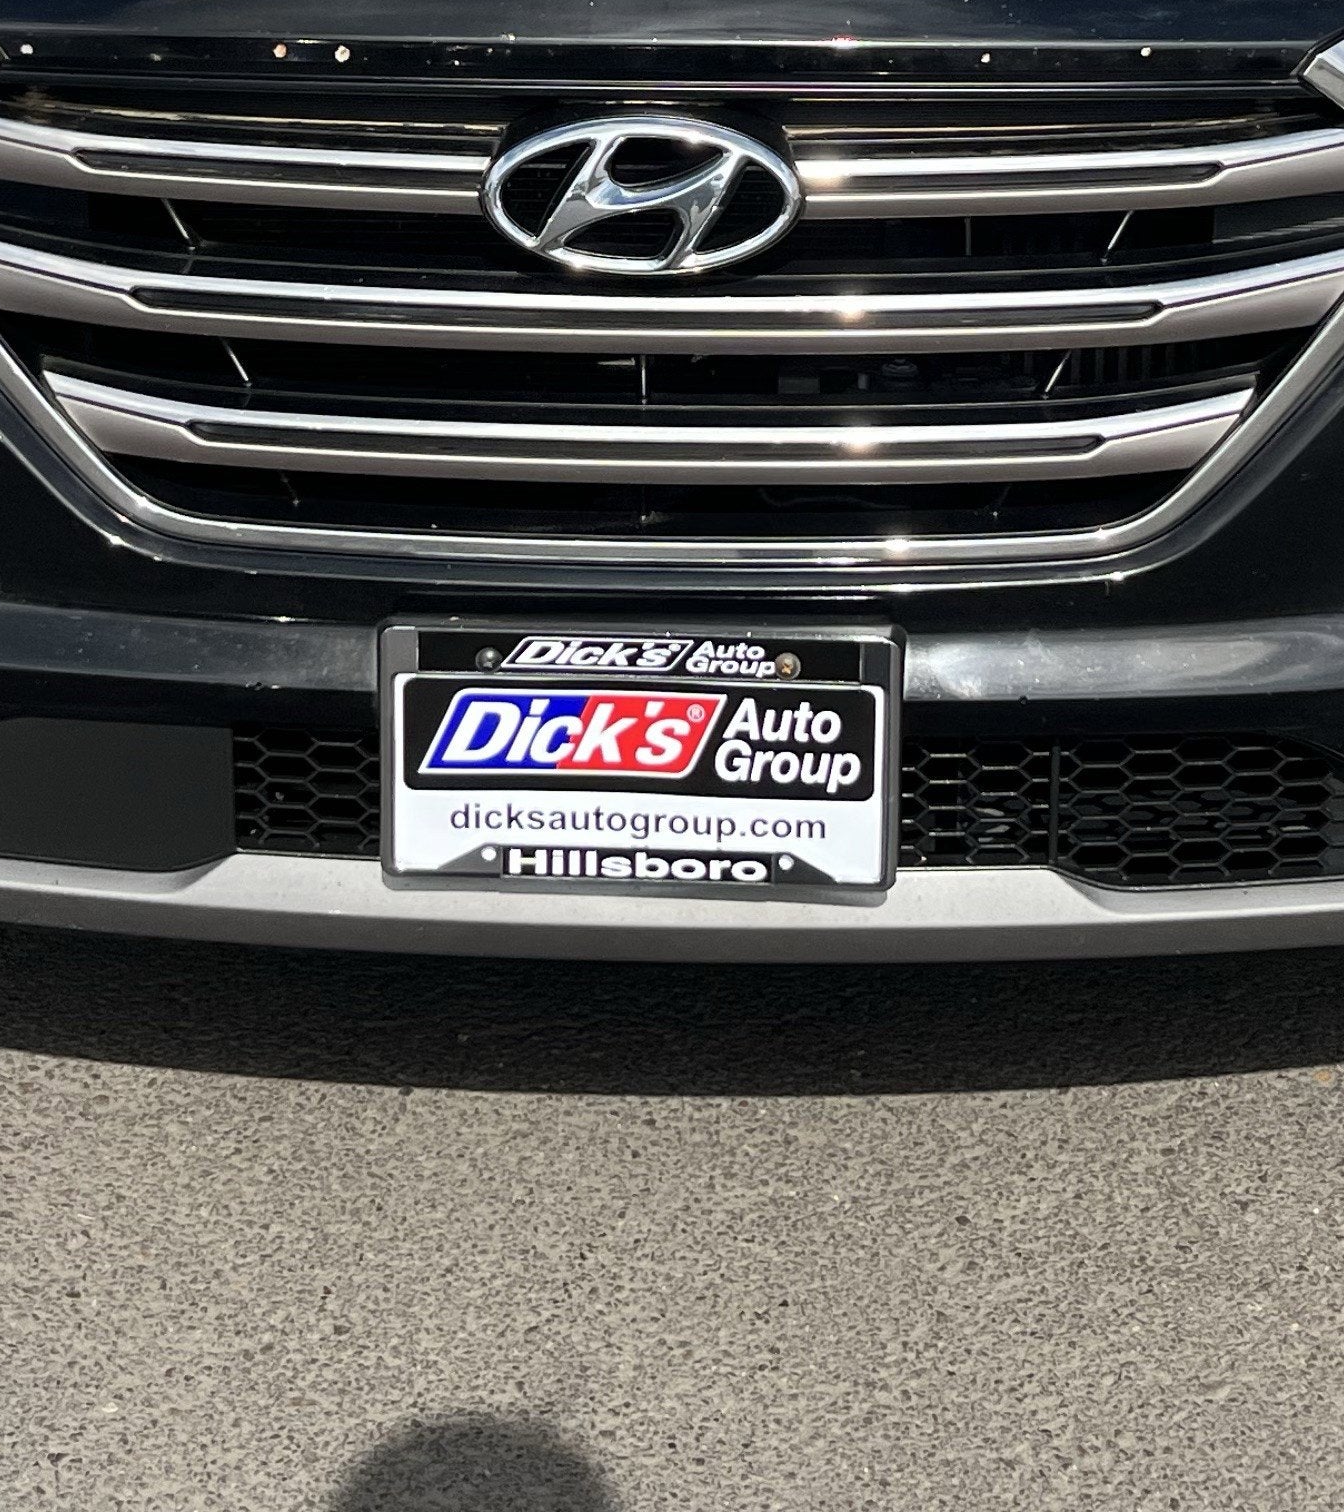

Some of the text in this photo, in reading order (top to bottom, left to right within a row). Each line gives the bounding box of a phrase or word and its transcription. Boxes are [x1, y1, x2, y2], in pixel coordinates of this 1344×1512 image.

[685, 656, 777, 678] Group
[694, 641, 766, 660] Auto
[441, 697, 842, 765] Dick's Auto
[714, 739, 862, 793] Group
[449, 803, 827, 841] dicksautogroup.com
[507, 846, 769, 882] Hillsboro
